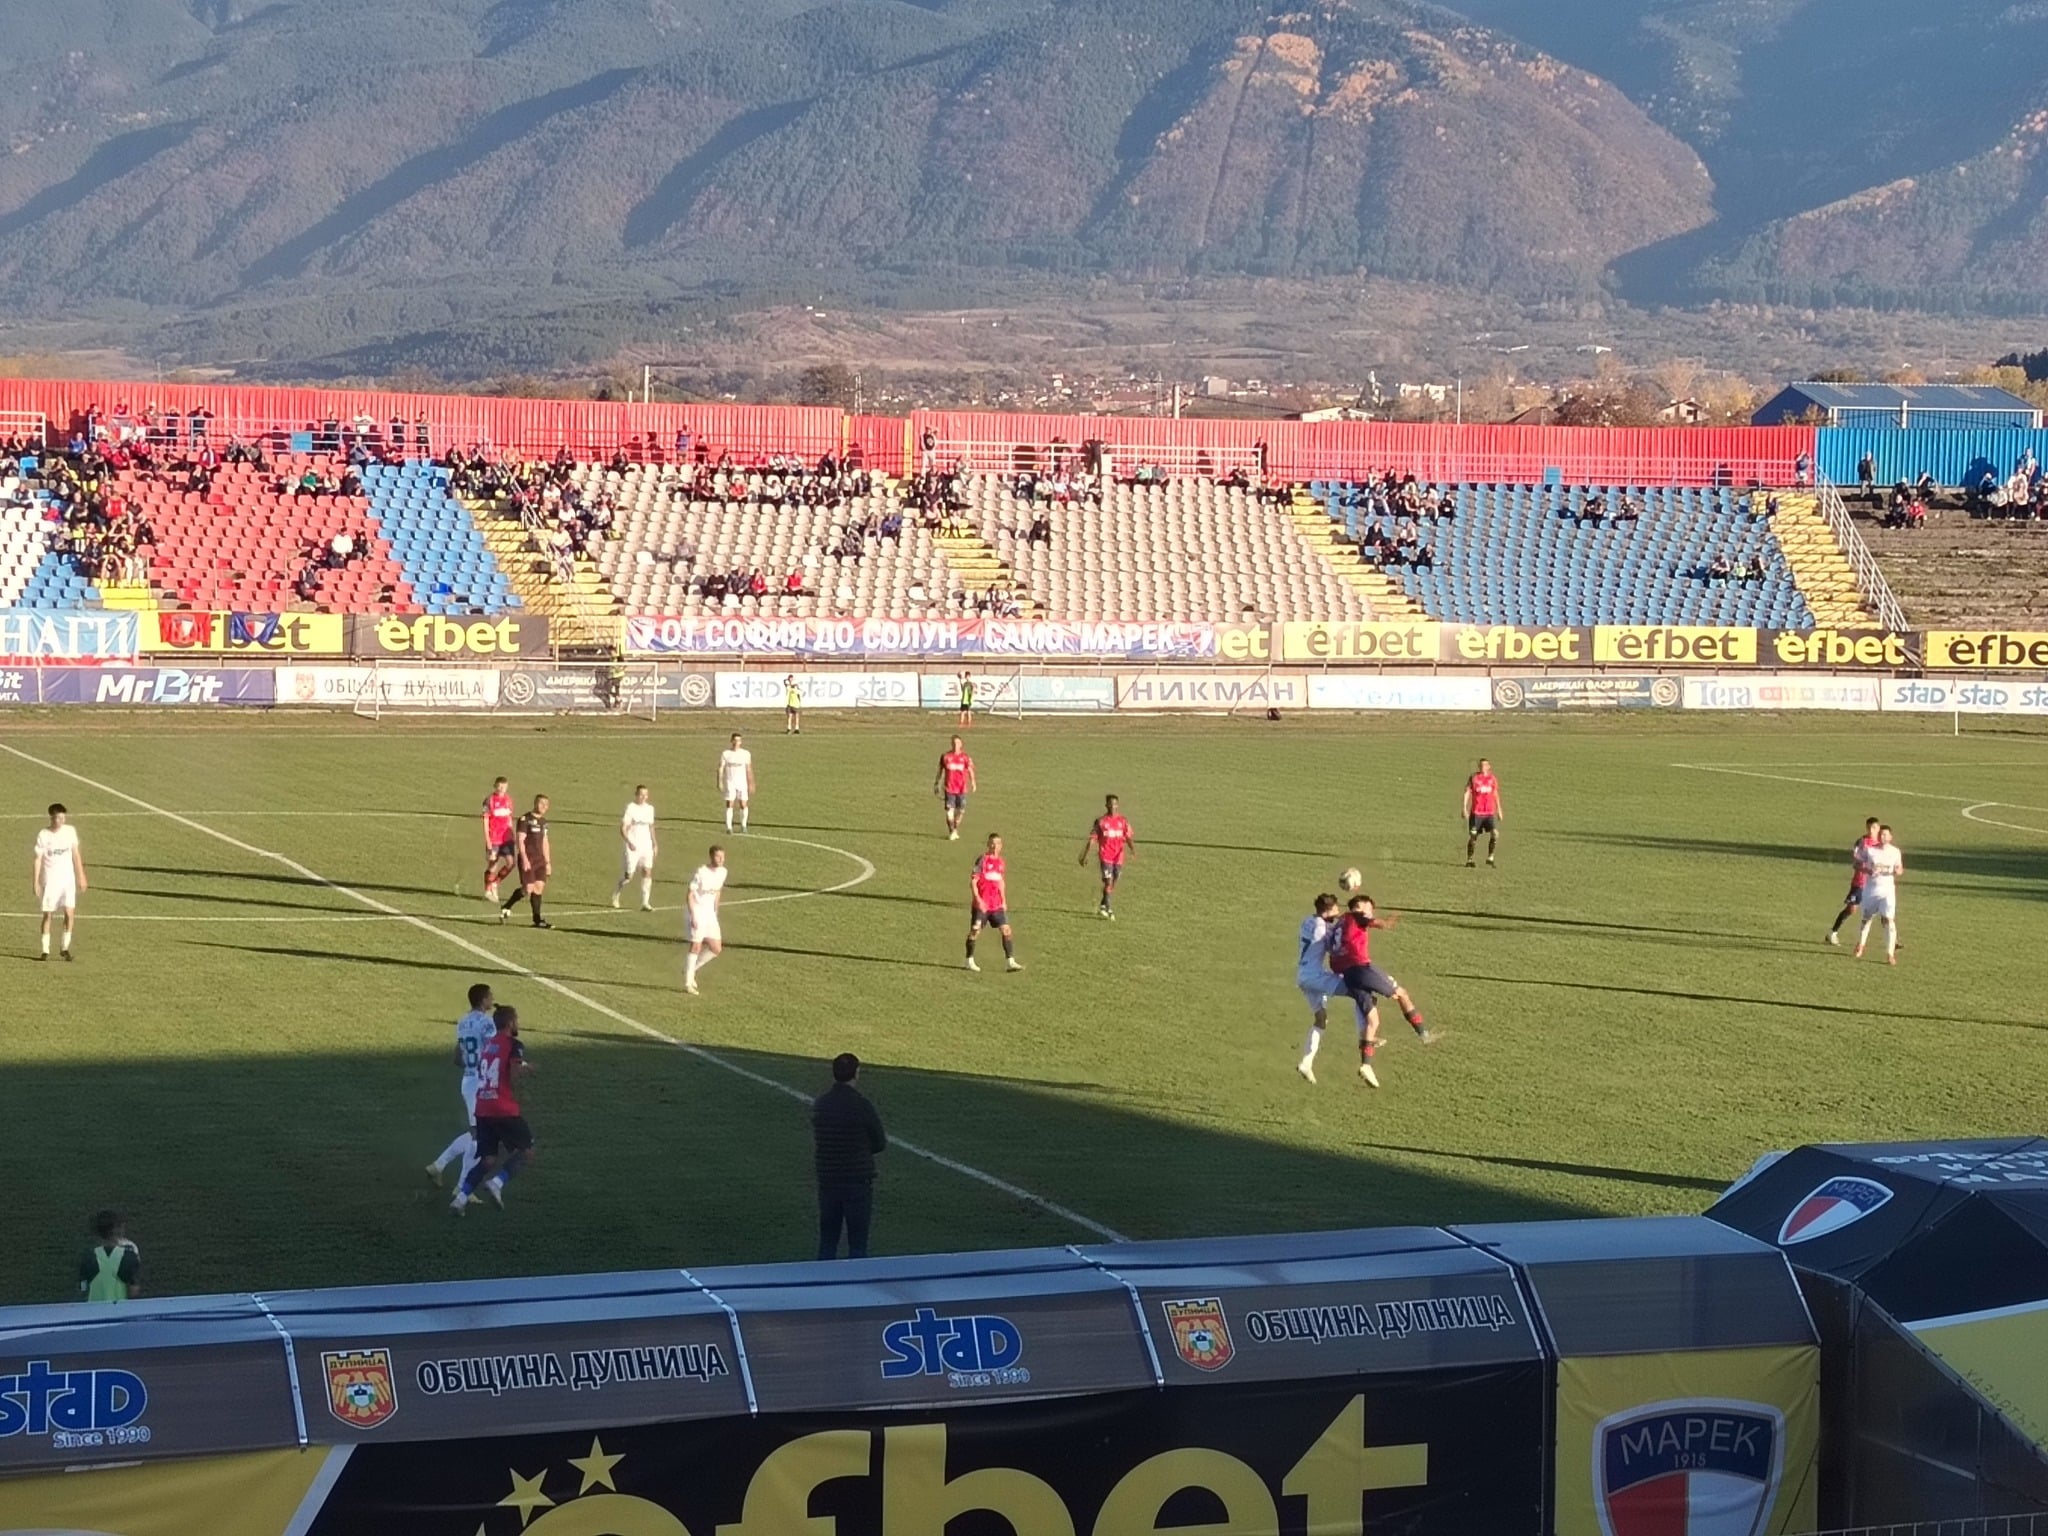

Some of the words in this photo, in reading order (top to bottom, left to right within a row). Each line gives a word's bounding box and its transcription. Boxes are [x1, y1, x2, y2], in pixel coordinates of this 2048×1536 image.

[661, 619, 698, 648] ОТ
[704, 619, 806, 650] СОФИЯ
[813, 619, 855, 651] ДО
[863, 620, 957, 649] СОЛУН
[984, 620, 1066, 651] САМО
[1080, 621, 1176, 651] МАРЕК
[1305, 624, 1422, 657] efbet
[1457, 625, 1580, 661] efbet
[1616, 628, 1739, 661] efbet
[1775, 630, 1905, 666] efbet
[96, 669, 223, 703] MrBit
[1133, 681, 1293, 701] НИКМАН
[1245, 1303, 1376, 1345] ОБЩИНА
[1377, 1294, 1516, 1340] ДУПНИЦА
[330, 1359, 385, 1369] ДУПНИЦА
[416, 1352, 567, 1397] ОБЩИНА
[570, 1343, 729, 1391] ДУПНИЦА
[948, 1371, 990, 1389] Since
[992, 1368, 1031, 1385] 1990
[53, 1431, 104, 1449] Since
[106, 1425, 151, 1444] 1990
[1619, 1418, 1761, 1465] МАРЕК
[1673, 1453, 1707, 1468] 1915
